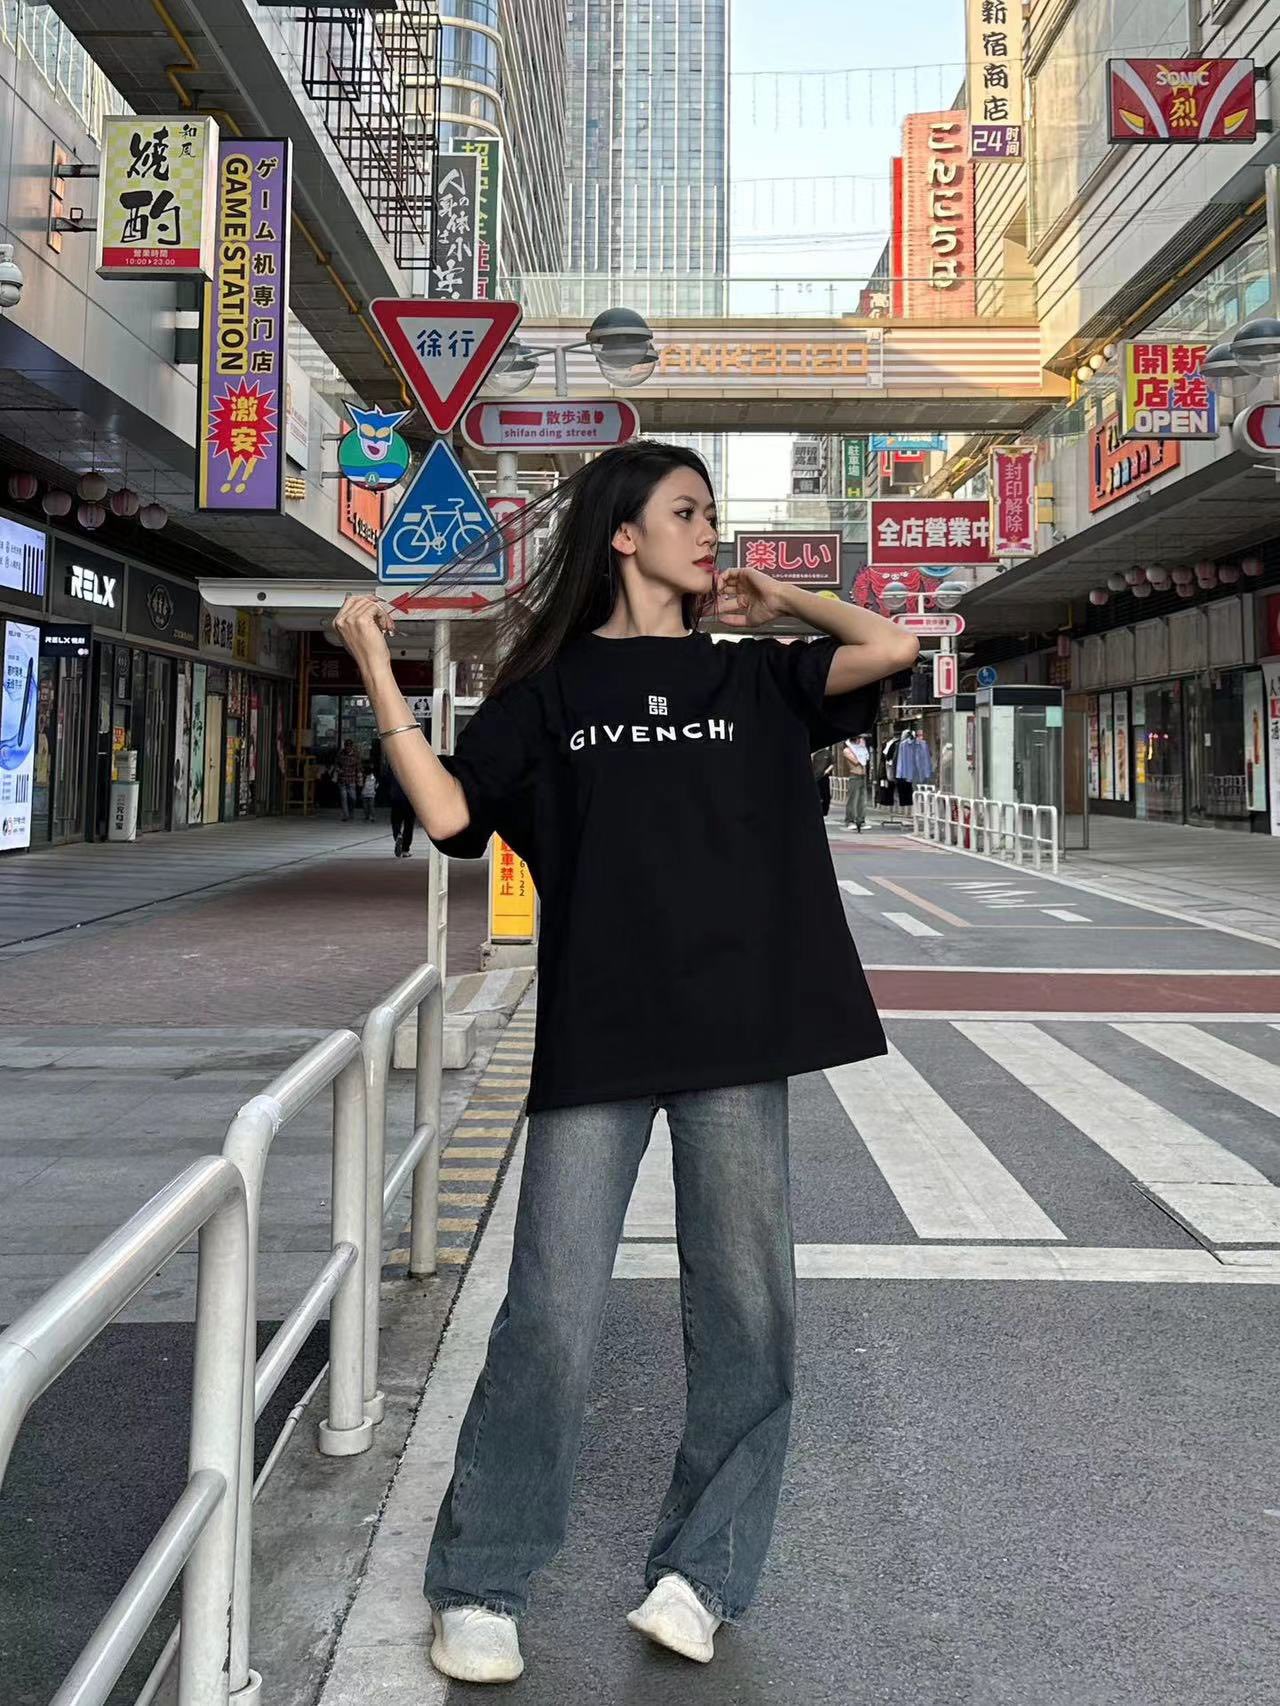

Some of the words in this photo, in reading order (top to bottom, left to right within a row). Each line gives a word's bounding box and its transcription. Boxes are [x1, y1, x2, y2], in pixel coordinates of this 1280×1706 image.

[982, 0, 1010, 121] 新宿商店
[1156, 71, 1210, 86] SONIC
[1169, 97, 1199, 127] 烈
[973, 131, 1002, 153] 24
[928, 122, 963, 291] こんにちは
[220, 156, 250, 373] GAMESTATION
[416, 329, 475, 358] 徐行
[566, 428, 597, 438] street
[1134, 410, 1208, 433] OPEN
[1005, 462, 1024, 534] 封印解除
[746, 539, 832, 570] 楽しい
[71, 565, 116, 609] RELX
